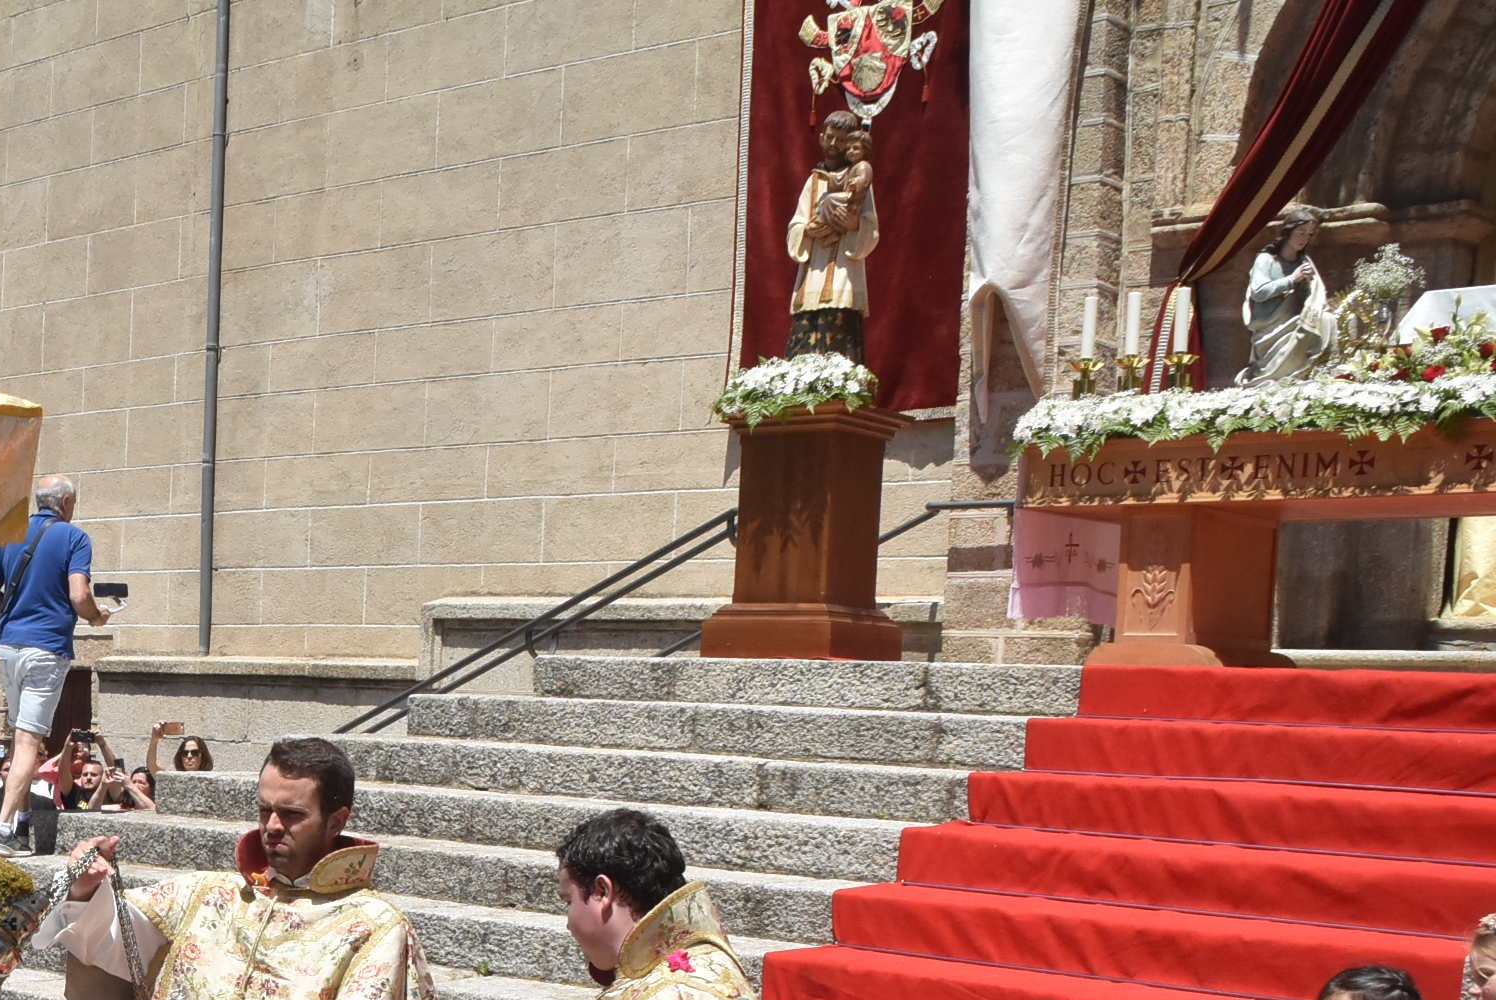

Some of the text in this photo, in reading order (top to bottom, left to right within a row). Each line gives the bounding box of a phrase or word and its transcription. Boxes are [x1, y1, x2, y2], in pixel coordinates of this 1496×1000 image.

[1049, 451, 1340, 487] HOC EST ENIM
